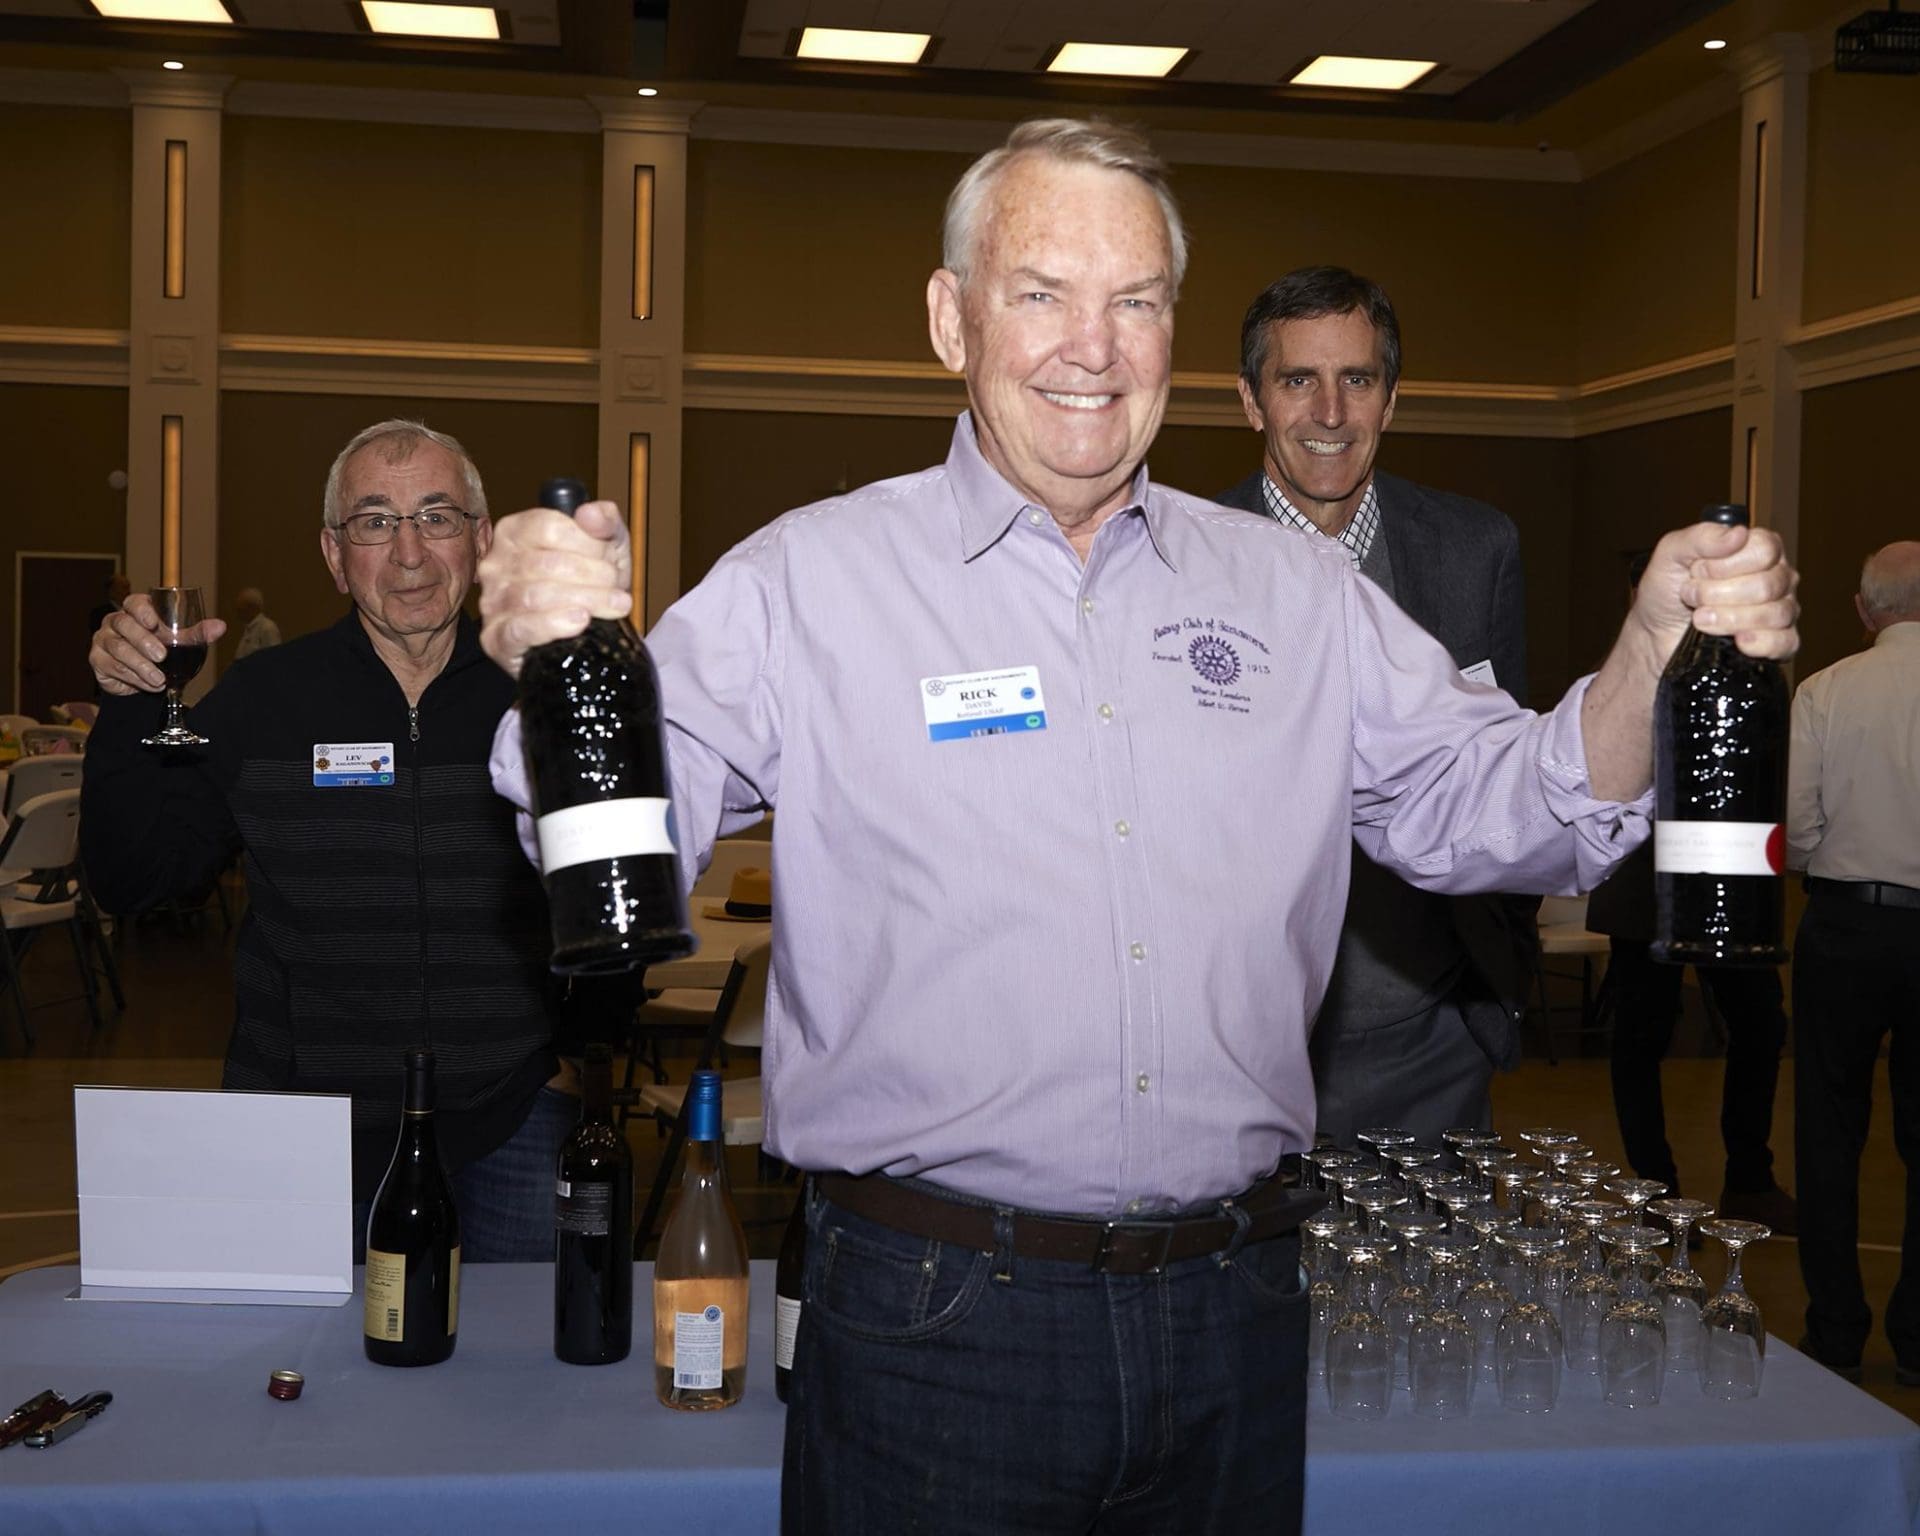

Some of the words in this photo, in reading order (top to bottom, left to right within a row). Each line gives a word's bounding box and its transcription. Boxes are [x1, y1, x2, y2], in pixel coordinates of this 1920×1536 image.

[1183, 617, 1203, 629] Club
[1205, 618, 1215, 632] of
[959, 687, 998, 702] RICK
[964, 700, 993, 710] DAVIS
